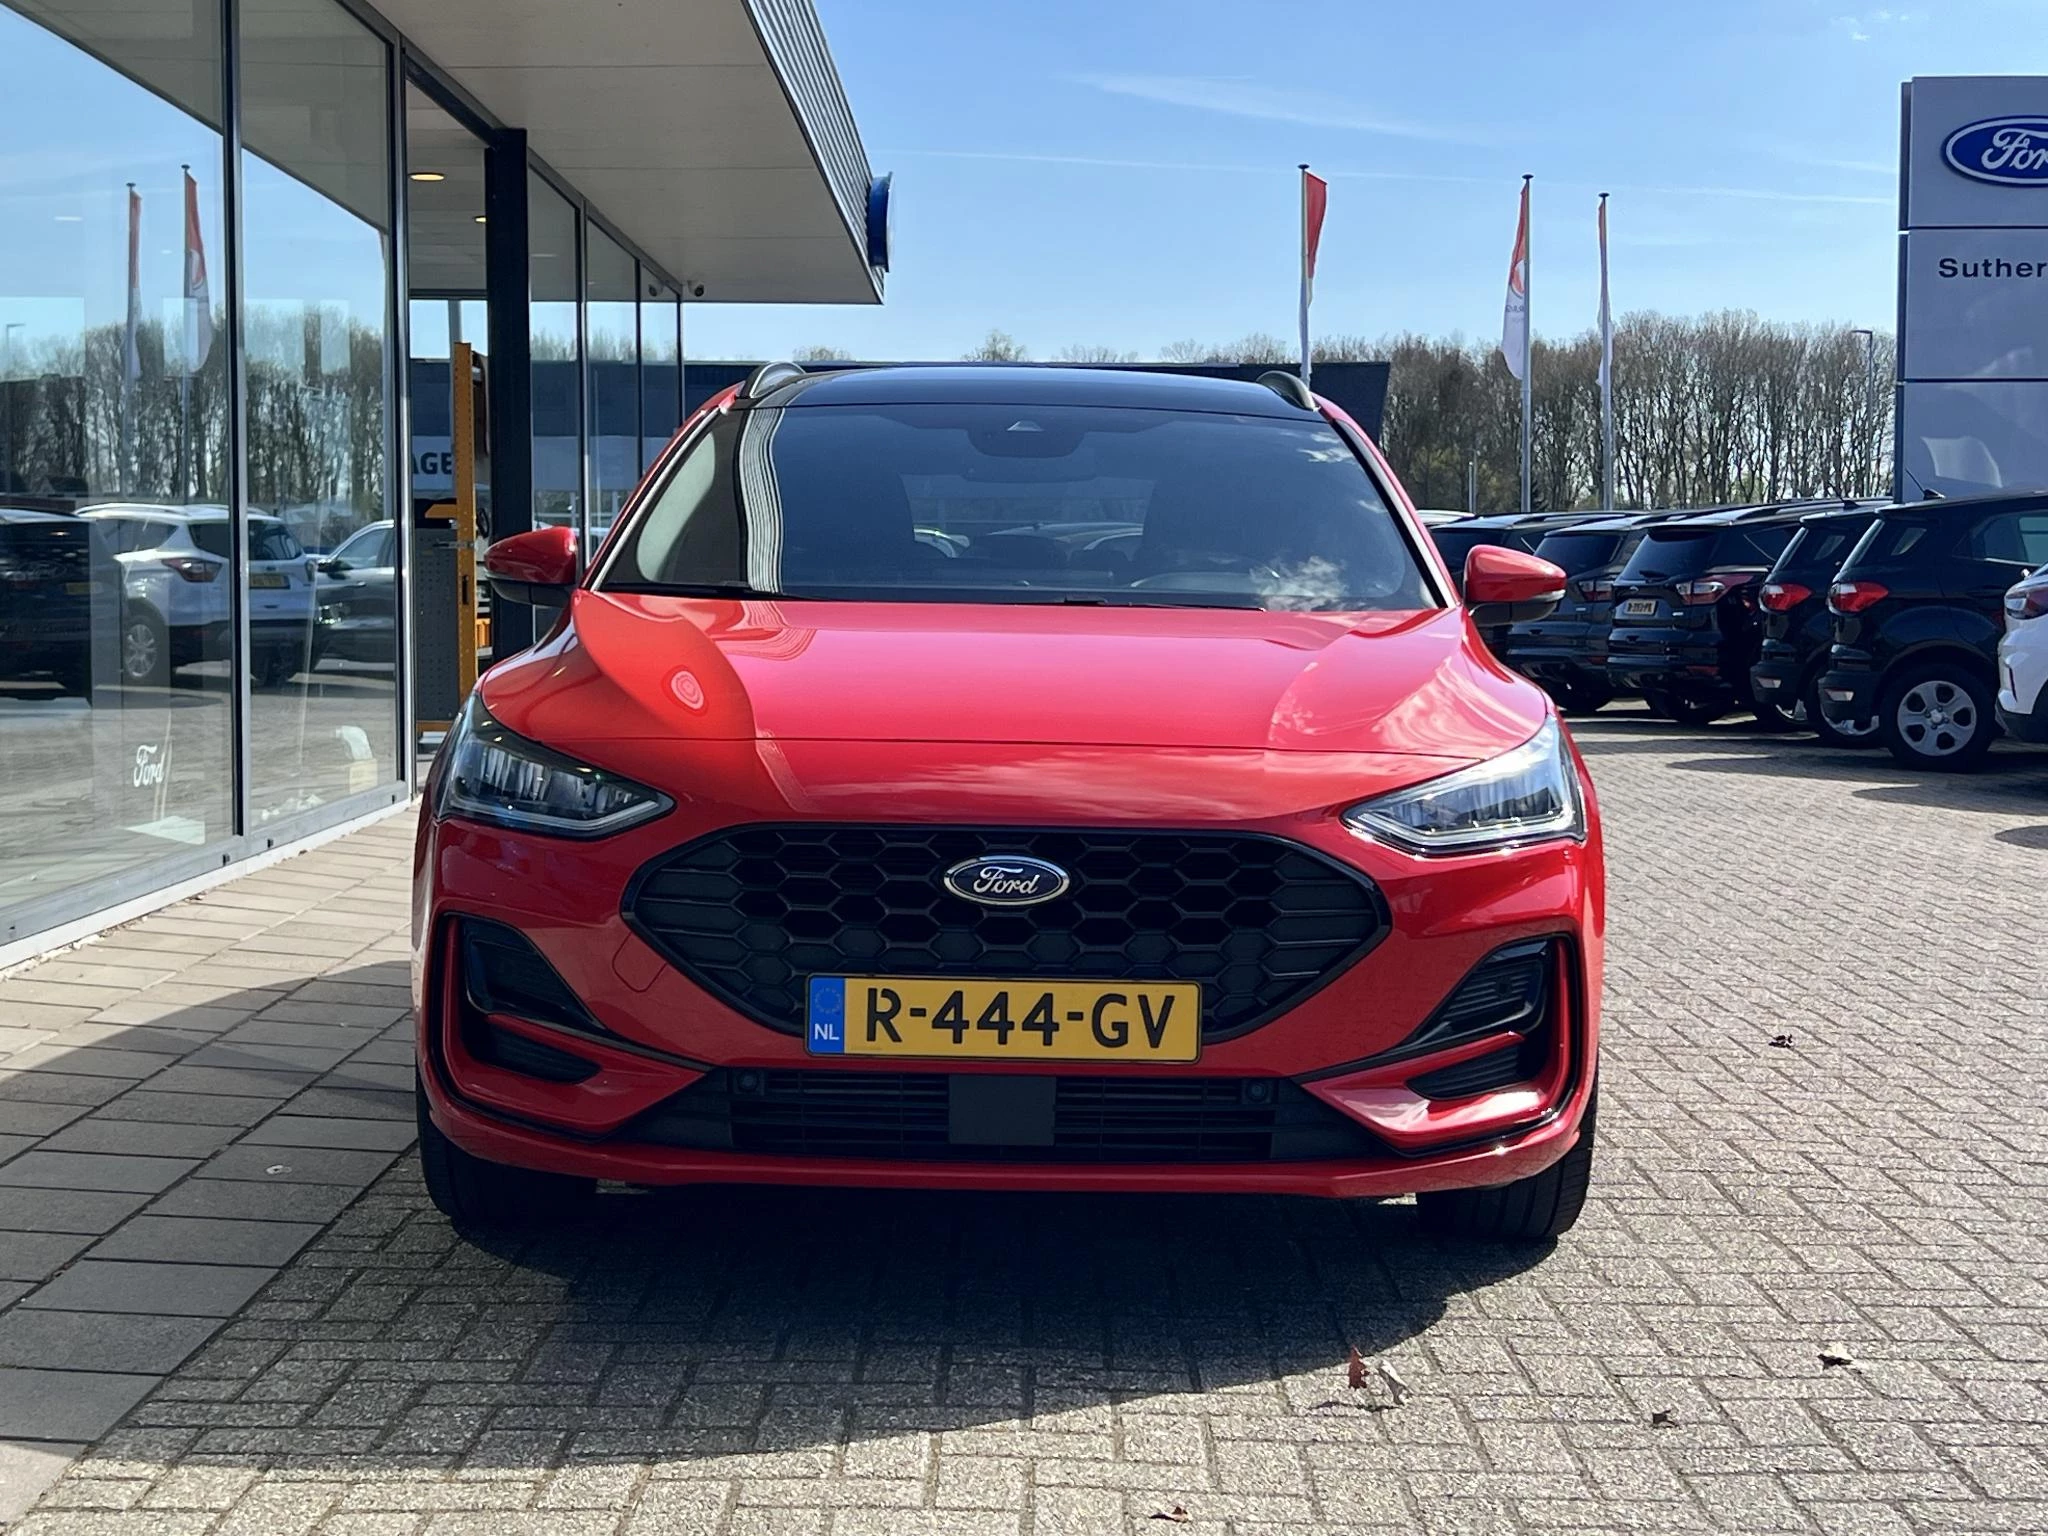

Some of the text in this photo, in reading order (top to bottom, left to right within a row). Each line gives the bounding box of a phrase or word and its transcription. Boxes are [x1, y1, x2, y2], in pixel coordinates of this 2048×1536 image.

[1938, 258, 2048, 279] Suther
[133, 744, 166, 787] Ford
[973, 865, 1040, 894] Ford
[814, 1023, 840, 1041] NL
[866, 987, 1175, 1049] R-444-GV
